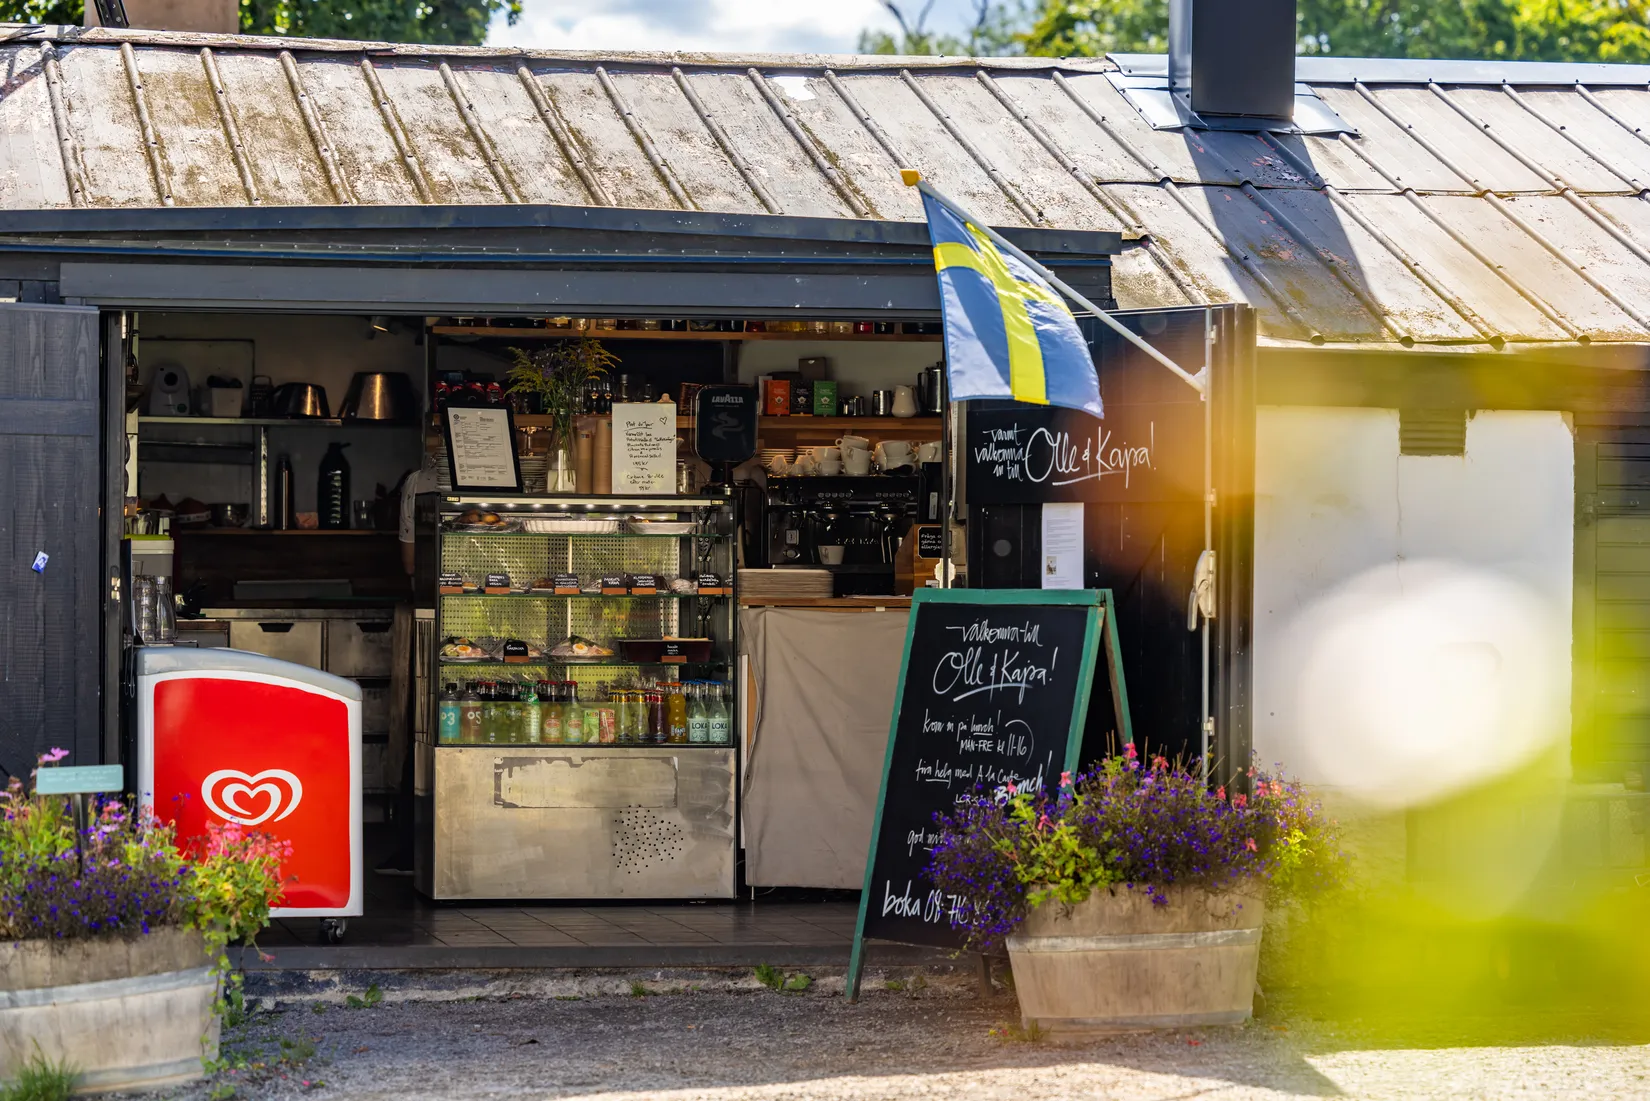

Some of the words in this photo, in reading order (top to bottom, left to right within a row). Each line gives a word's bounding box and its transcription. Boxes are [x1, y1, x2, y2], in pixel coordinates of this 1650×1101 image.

[711, 393, 744, 404] LAVAZZA
[983, 423, 1027, 445] varmt
[975, 441, 1031, 464] välkomna
[1024, 427, 1080, 482] Olle
[992, 463, 1004, 477] in
[1007, 463, 1024, 481] till
[946, 618, 1019, 644] välkomna
[1020, 621, 1043, 647] till
[933, 648, 983, 695] Olle
[1000, 647, 1059, 705] Kajsa!
[922, 709, 945, 734] kom
[946, 715, 955, 733] in
[957, 719, 969, 742] på
[959, 736, 995, 755] MÅN-FRE
[915, 758, 933, 782] fira
[934, 759, 953, 789] helg
[954, 763, 974, 780] med
[907, 827, 925, 858] god
[881, 879, 921, 918] boka
